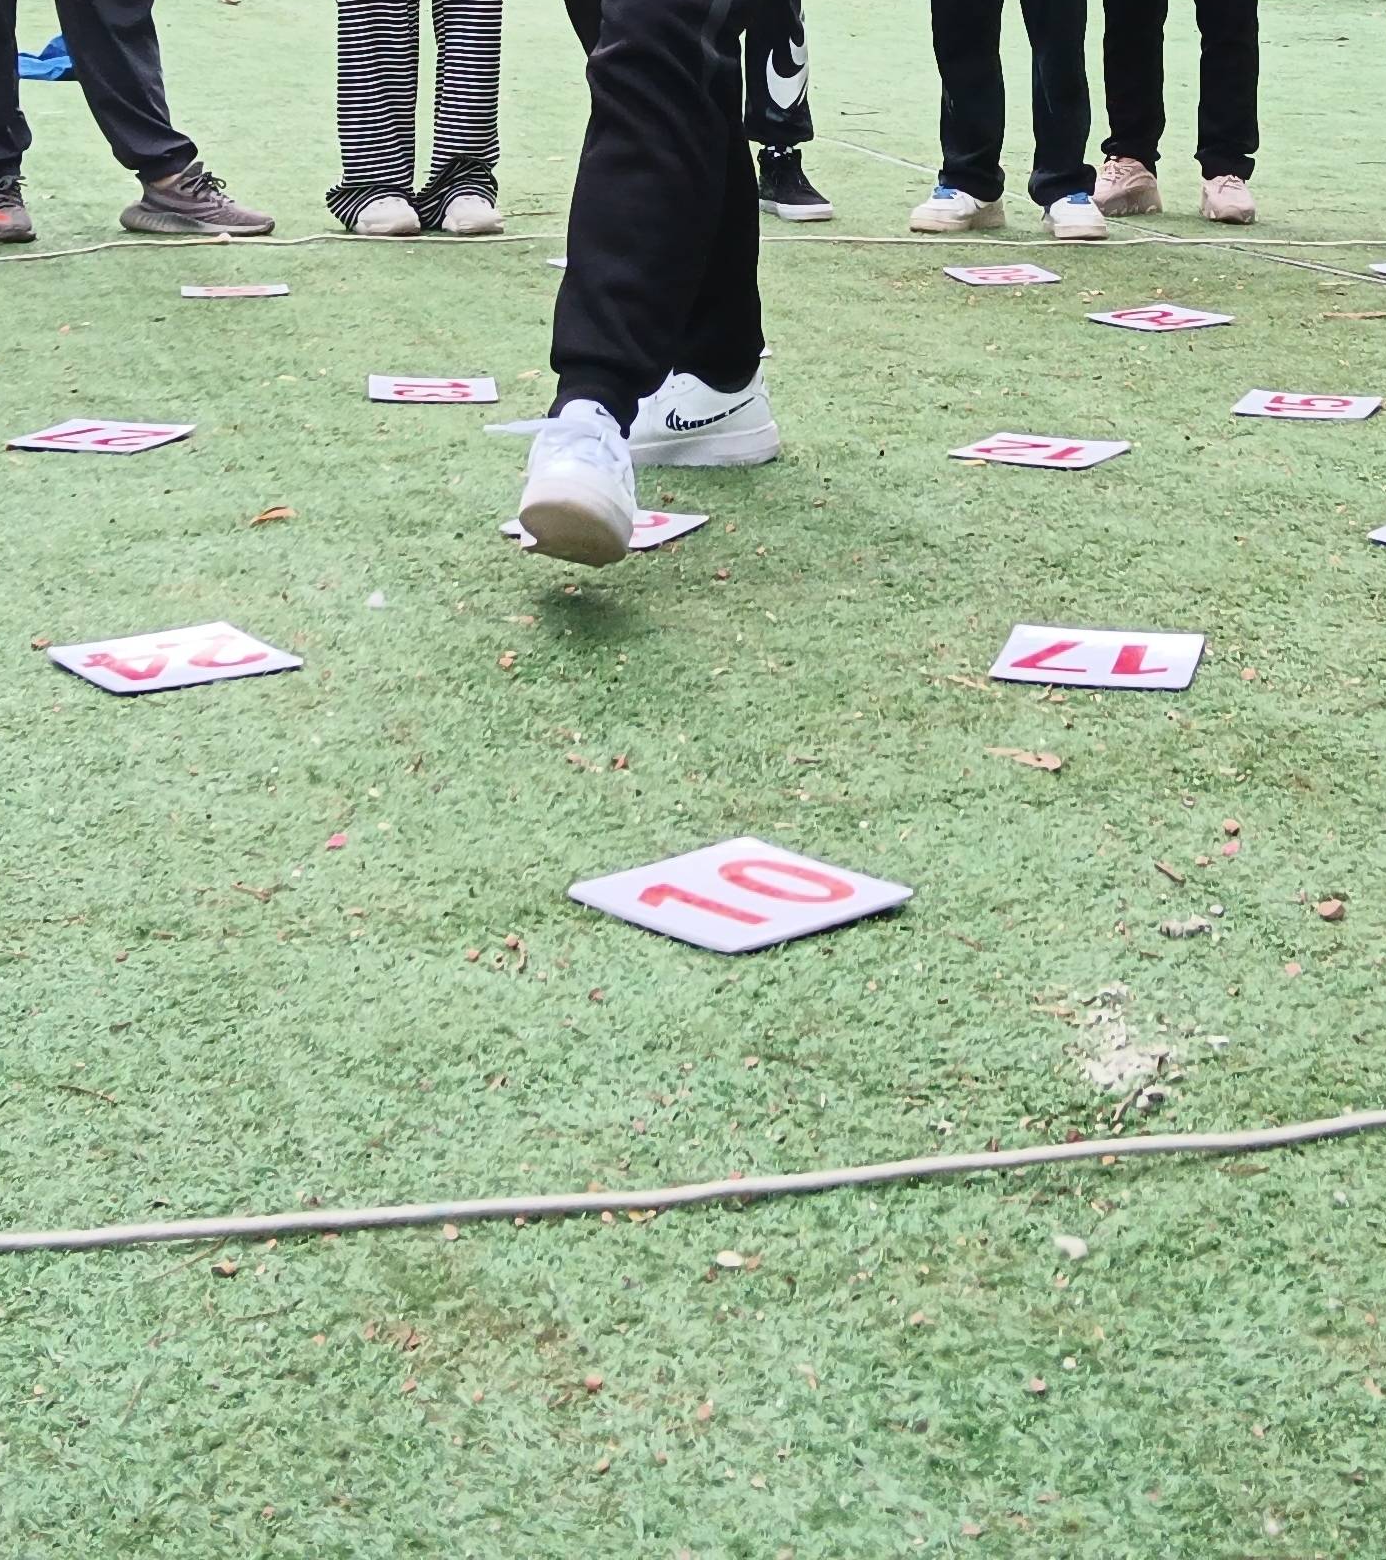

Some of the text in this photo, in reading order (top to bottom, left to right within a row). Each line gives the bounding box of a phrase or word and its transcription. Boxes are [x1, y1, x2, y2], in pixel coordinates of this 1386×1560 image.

[395, 382, 472, 400] 13
[1266, 395, 1352, 413] 15
[974, 439, 1086, 461] 12
[85, 635, 267, 683] 24
[638, 858, 857, 926] 10
